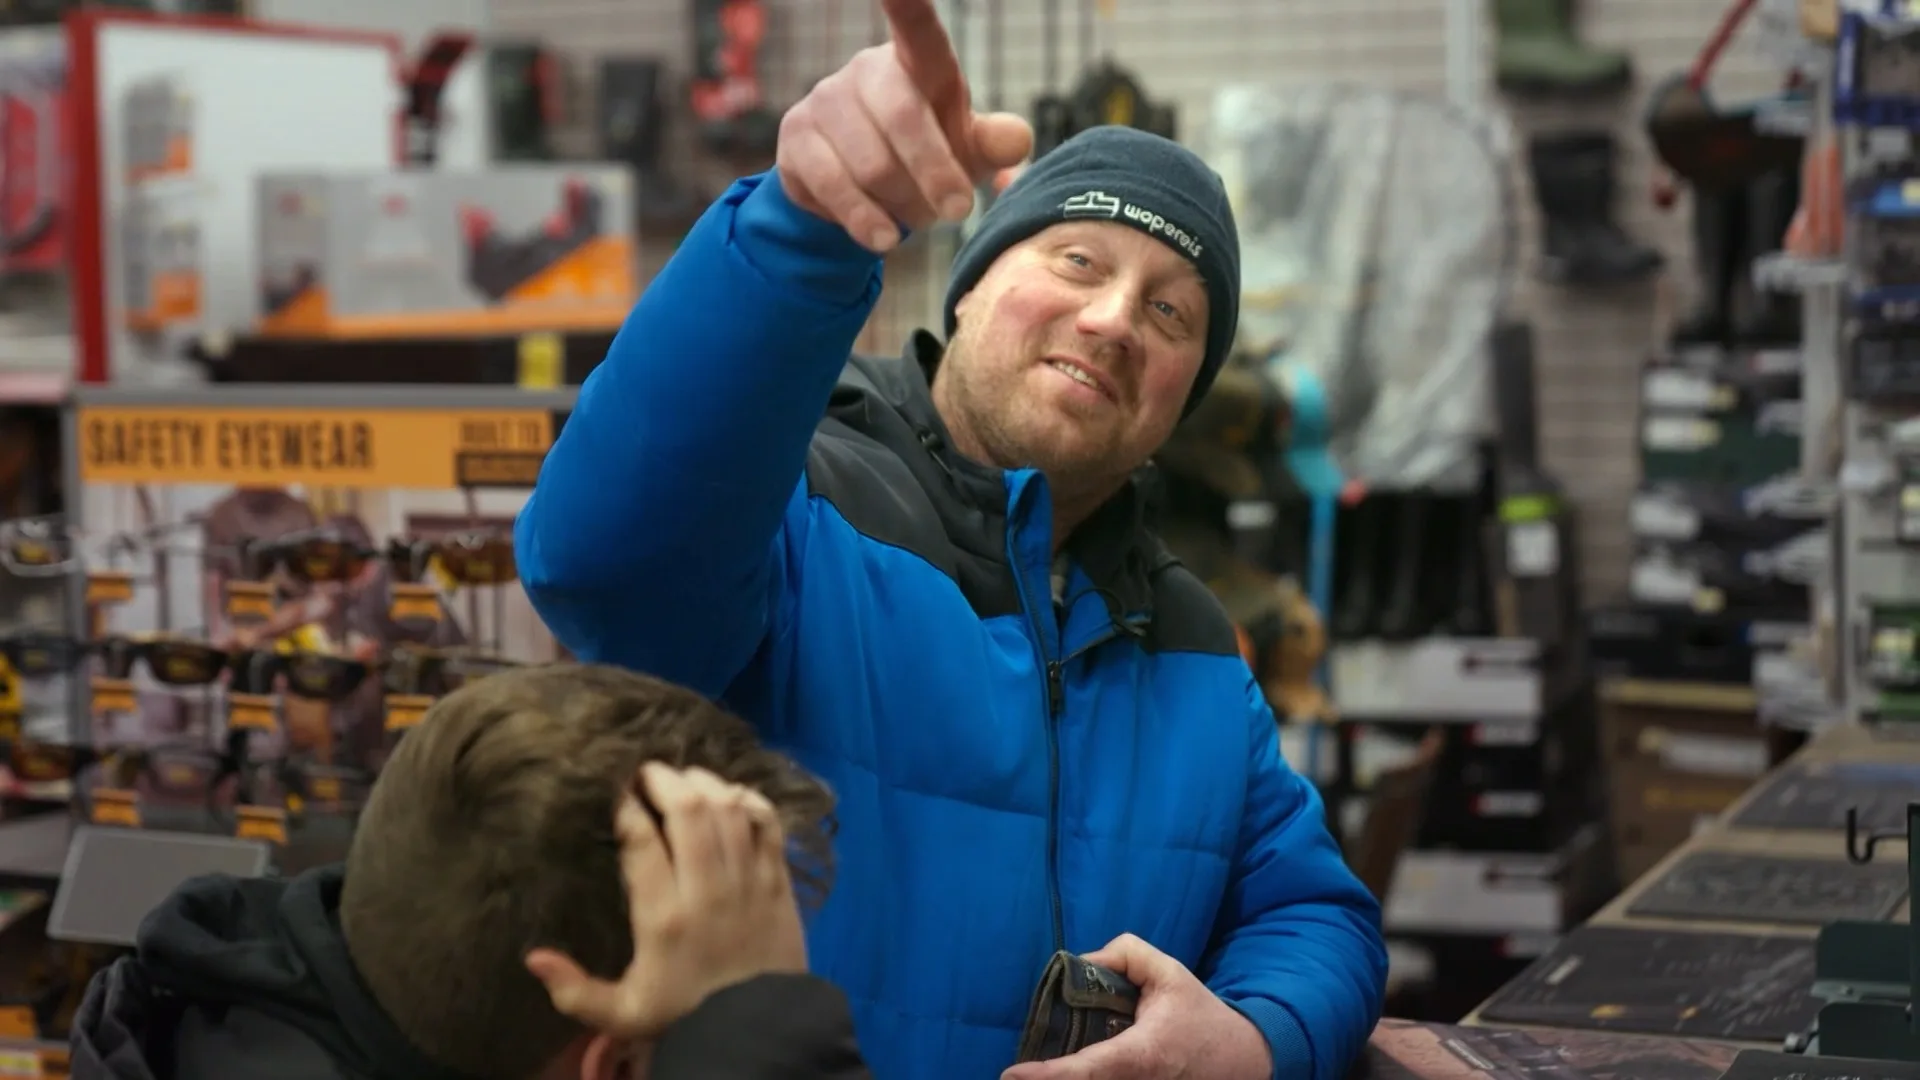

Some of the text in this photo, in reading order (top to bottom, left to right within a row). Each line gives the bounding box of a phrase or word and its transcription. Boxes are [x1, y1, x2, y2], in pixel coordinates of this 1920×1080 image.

[1123, 202, 1203, 258] wopereis
[88, 416, 375, 472] SAFETY EYEWEAR
